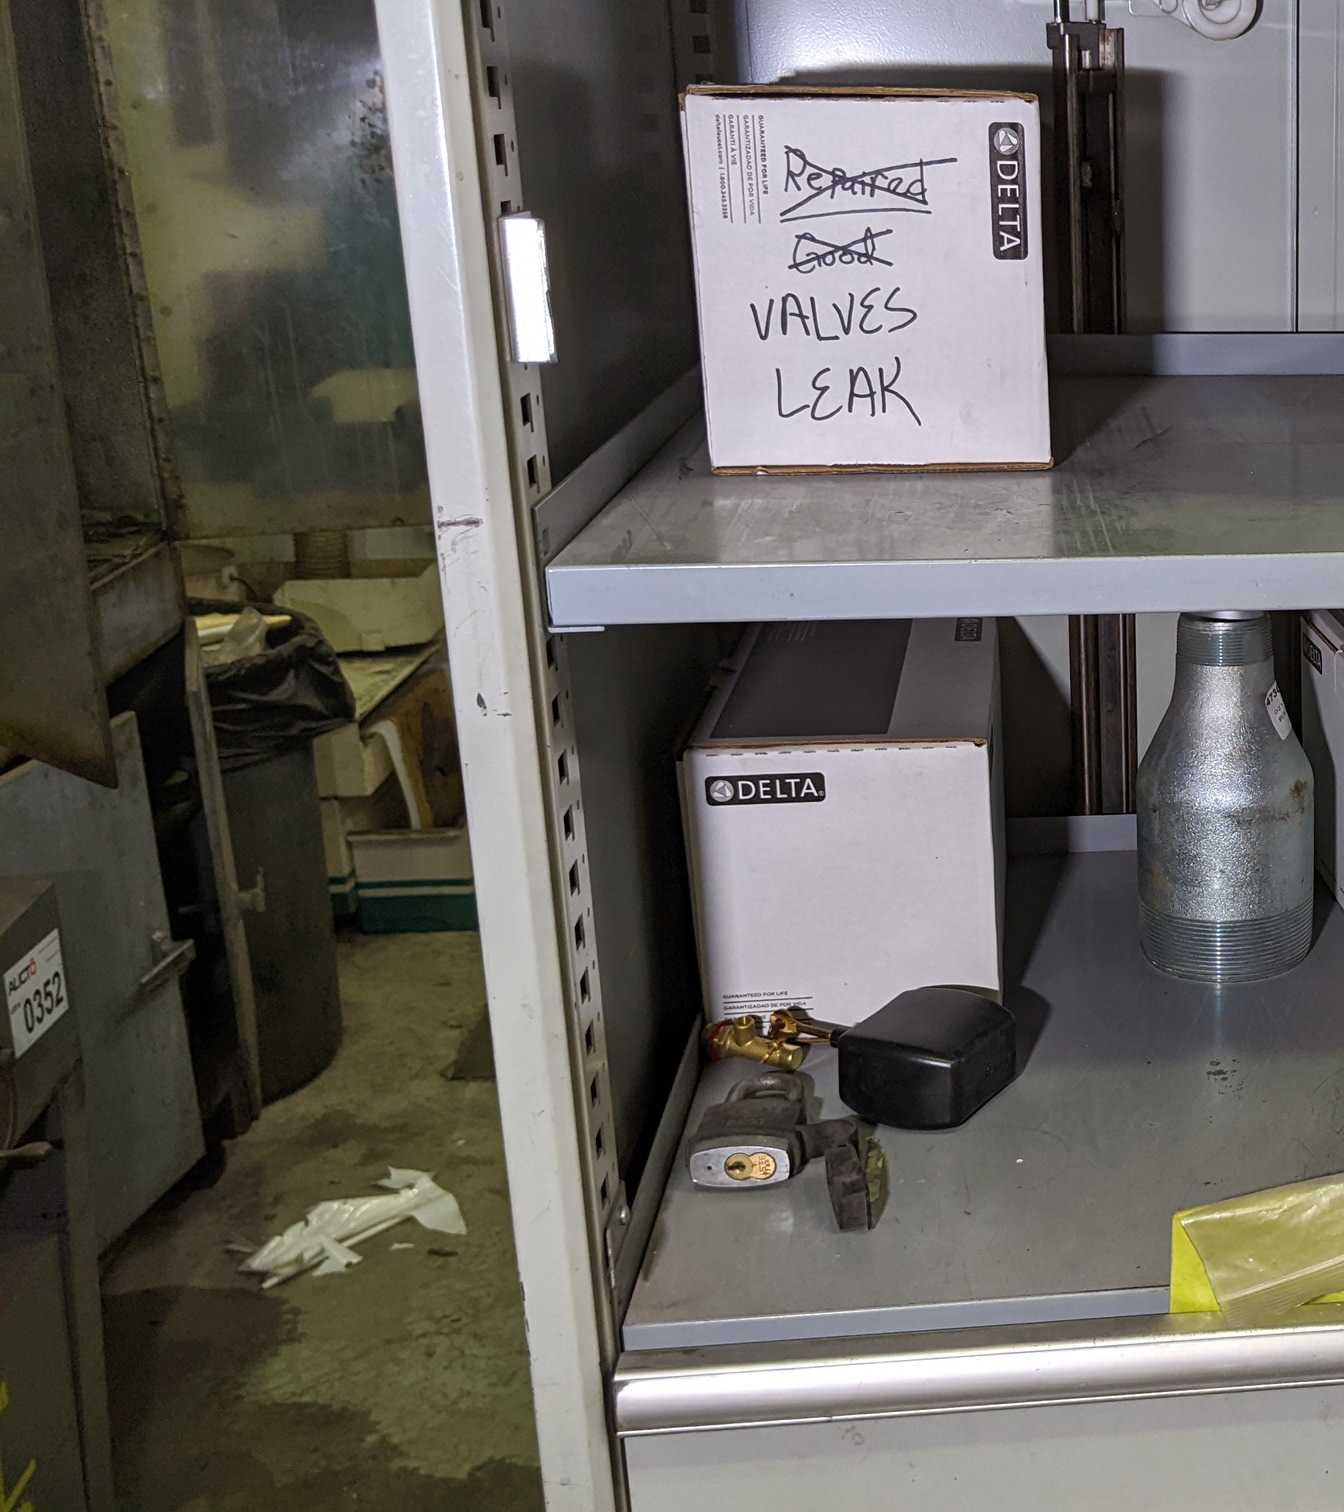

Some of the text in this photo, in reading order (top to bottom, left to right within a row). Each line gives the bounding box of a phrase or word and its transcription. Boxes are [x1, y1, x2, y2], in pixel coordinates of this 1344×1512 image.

[758, 115, 767, 163] GUARANTEED
[746, 171, 753, 181] DE
[996, 160, 1021, 251] DELTA
[750, 287, 918, 341] VALVES
[775, 356, 922, 427] LEAK
[737, 777, 818, 800] DELTA
[24, 970, 64, 1034] 0352
